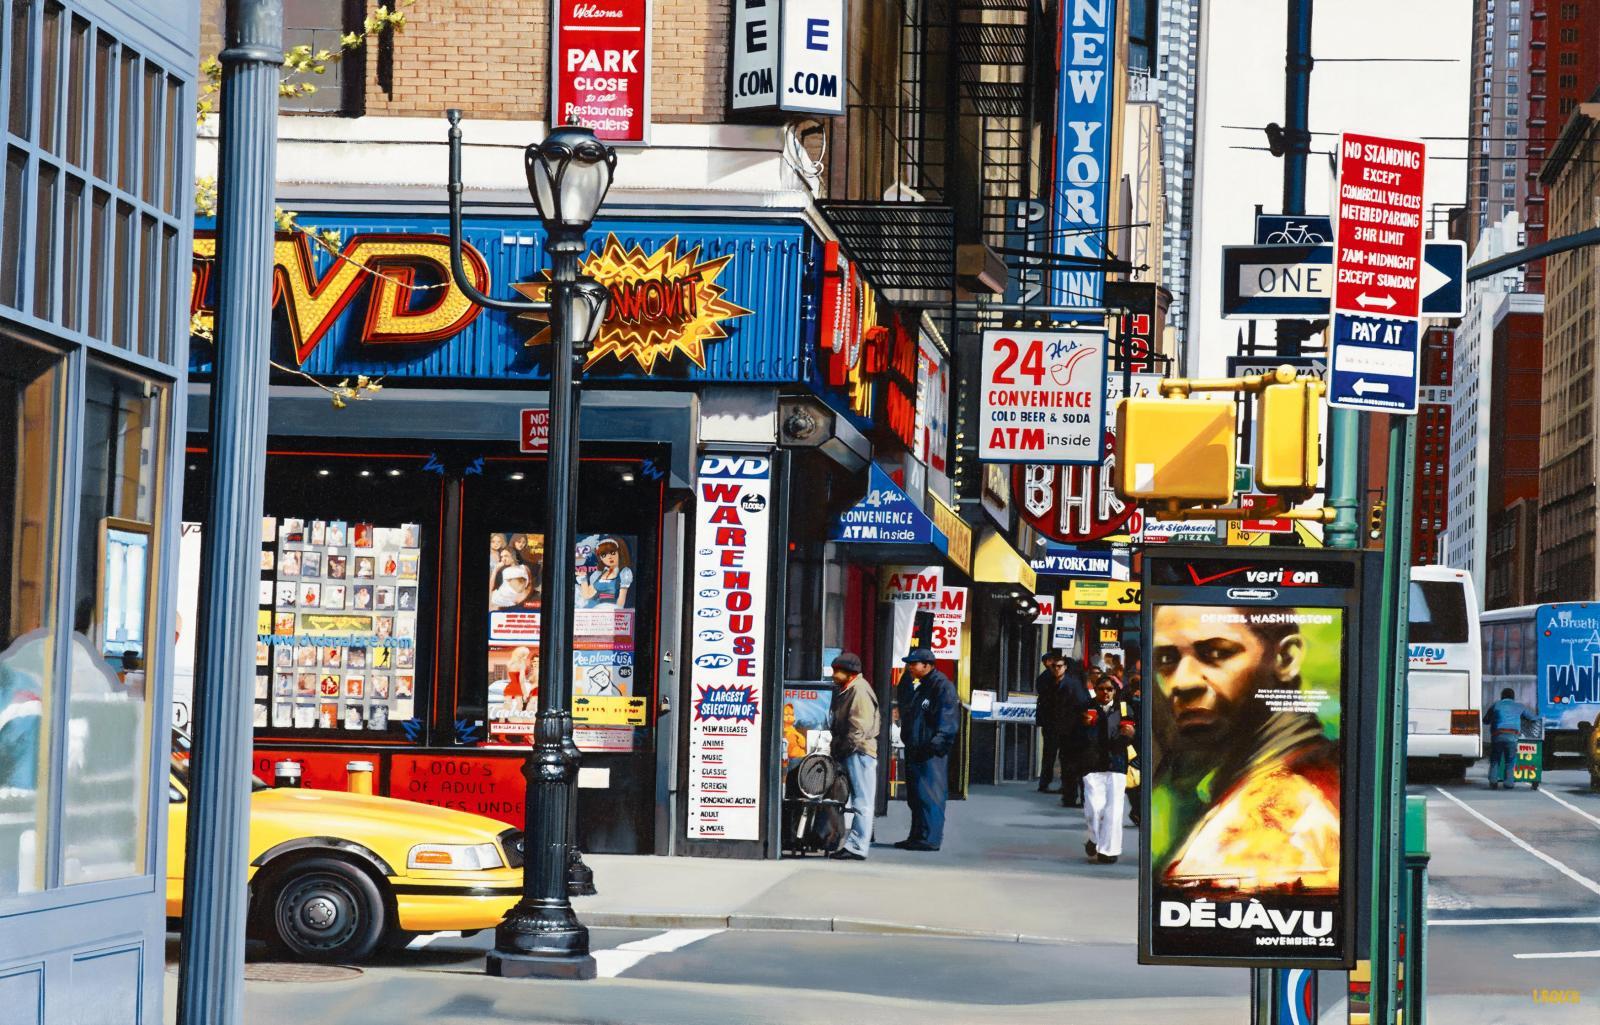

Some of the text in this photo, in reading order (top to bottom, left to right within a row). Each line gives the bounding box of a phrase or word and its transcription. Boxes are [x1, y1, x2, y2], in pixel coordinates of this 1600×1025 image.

[573, 3, 624, 19] Welcome
[567, 48, 640, 74] PARK
[573, 76, 629, 92] CLOSE
[734, 67, 774, 98] .COM
[788, 71, 837, 98] .COM
[1344, 140, 1420, 170] NO STANDING
[1363, 167, 1402, 186] EXCEPT
[1382, 209, 1420, 228] PARKING
[1354, 226, 1405, 246] 3 HR LIMIT
[1061, 271, 1095, 306] INN
[1258, 267, 1323, 293] ONE
[1338, 269, 1417, 290] EXCEPT SUNDAY
[1351, 321, 1403, 345] PAY AT
[991, 337, 1046, 386] 24
[988, 390, 1092, 408] CONVENIENCE
[991, 410, 1091, 424] COLD BEER & SODA
[988, 427, 1091, 450] ATM inside
[700, 455, 769, 476] DVD
[841, 511, 914, 524] CONVENIENCE
[843, 525, 915, 541] ATM inside
[1178, 534, 1211, 542] PIZZA
[1056, 557, 1088, 571] YORK
[1087, 558, 1110, 572] INN
[702, 483, 757, 677] WAREHOUSE
[886, 573, 937, 592] ATM
[1246, 568, 1320, 585] verizon
[1250, 613, 1333, 625] WASHINGTON
[697, 655, 732, 667] DVD
[710, 691, 745, 702] LARGEST
[701, 703, 741, 716] SELECTION
[702, 725, 748, 733] NEW RELEASES
[441, 781, 496, 794] ADULT
[1256, 936, 1336, 947] NOVEMBER 22
